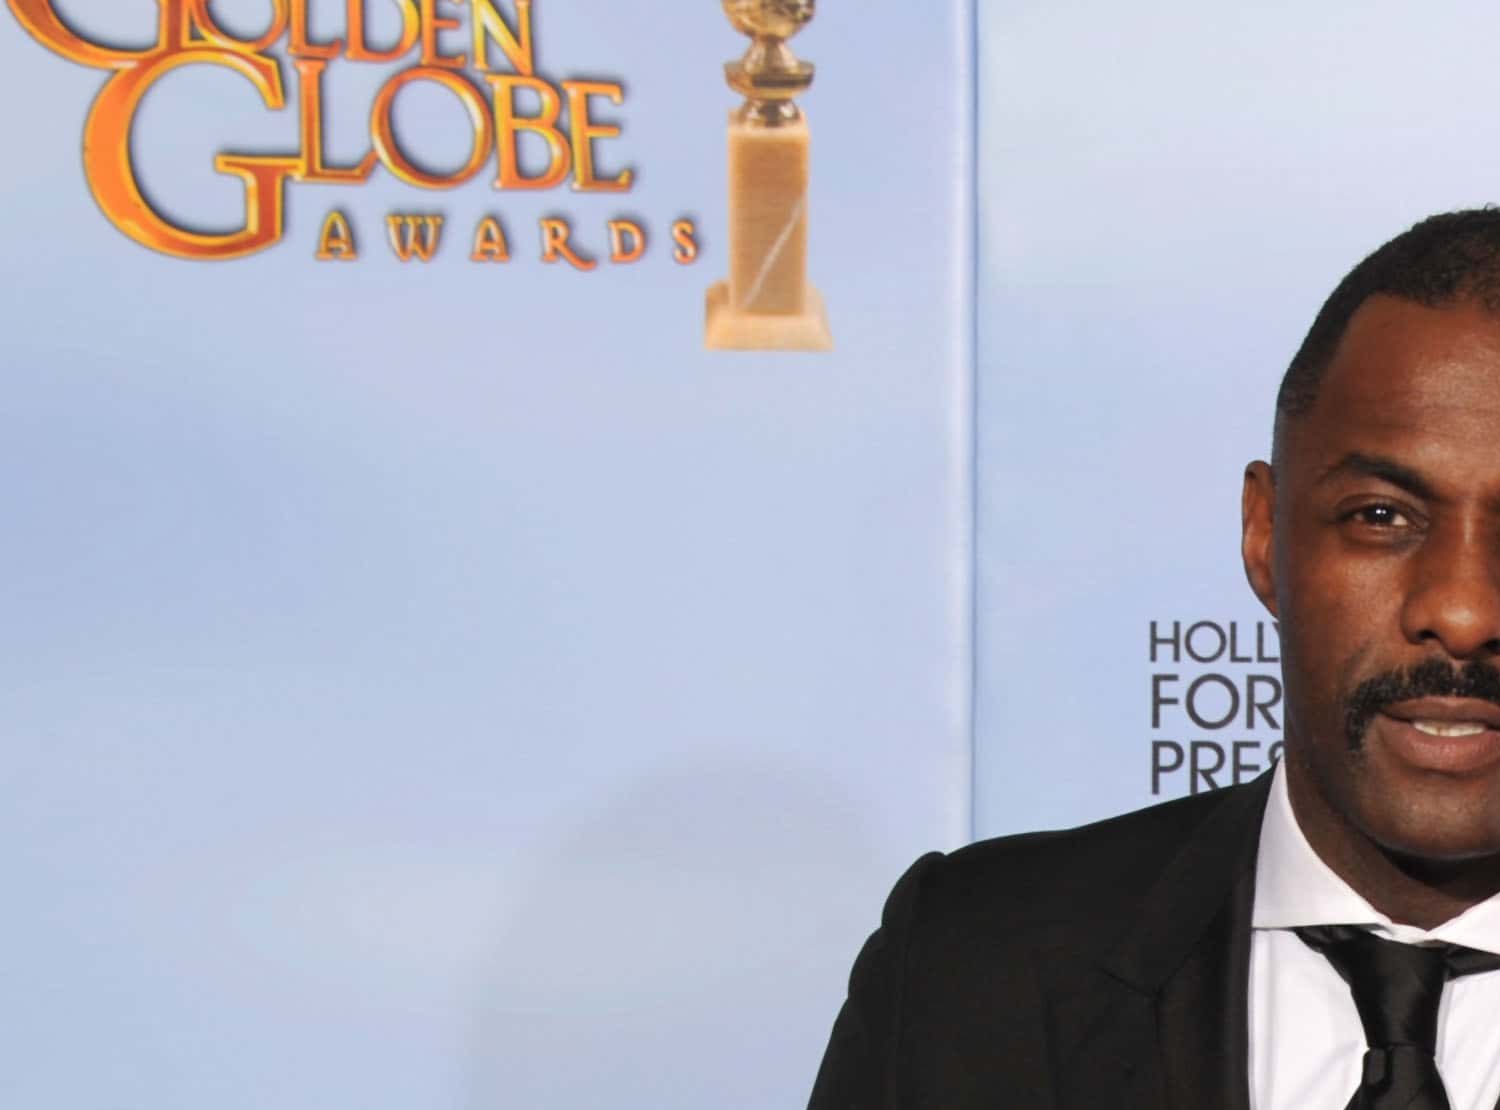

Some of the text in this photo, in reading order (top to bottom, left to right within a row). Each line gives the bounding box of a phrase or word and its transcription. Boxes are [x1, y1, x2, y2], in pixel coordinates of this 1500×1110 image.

[83, 49, 636, 260] GLOBE
[315, 211, 700, 270] AWARDS
[1149, 620, 1281, 663] HOLL
[1151, 673, 1283, 730] FOR
[1151, 740, 1285, 796] PRE
